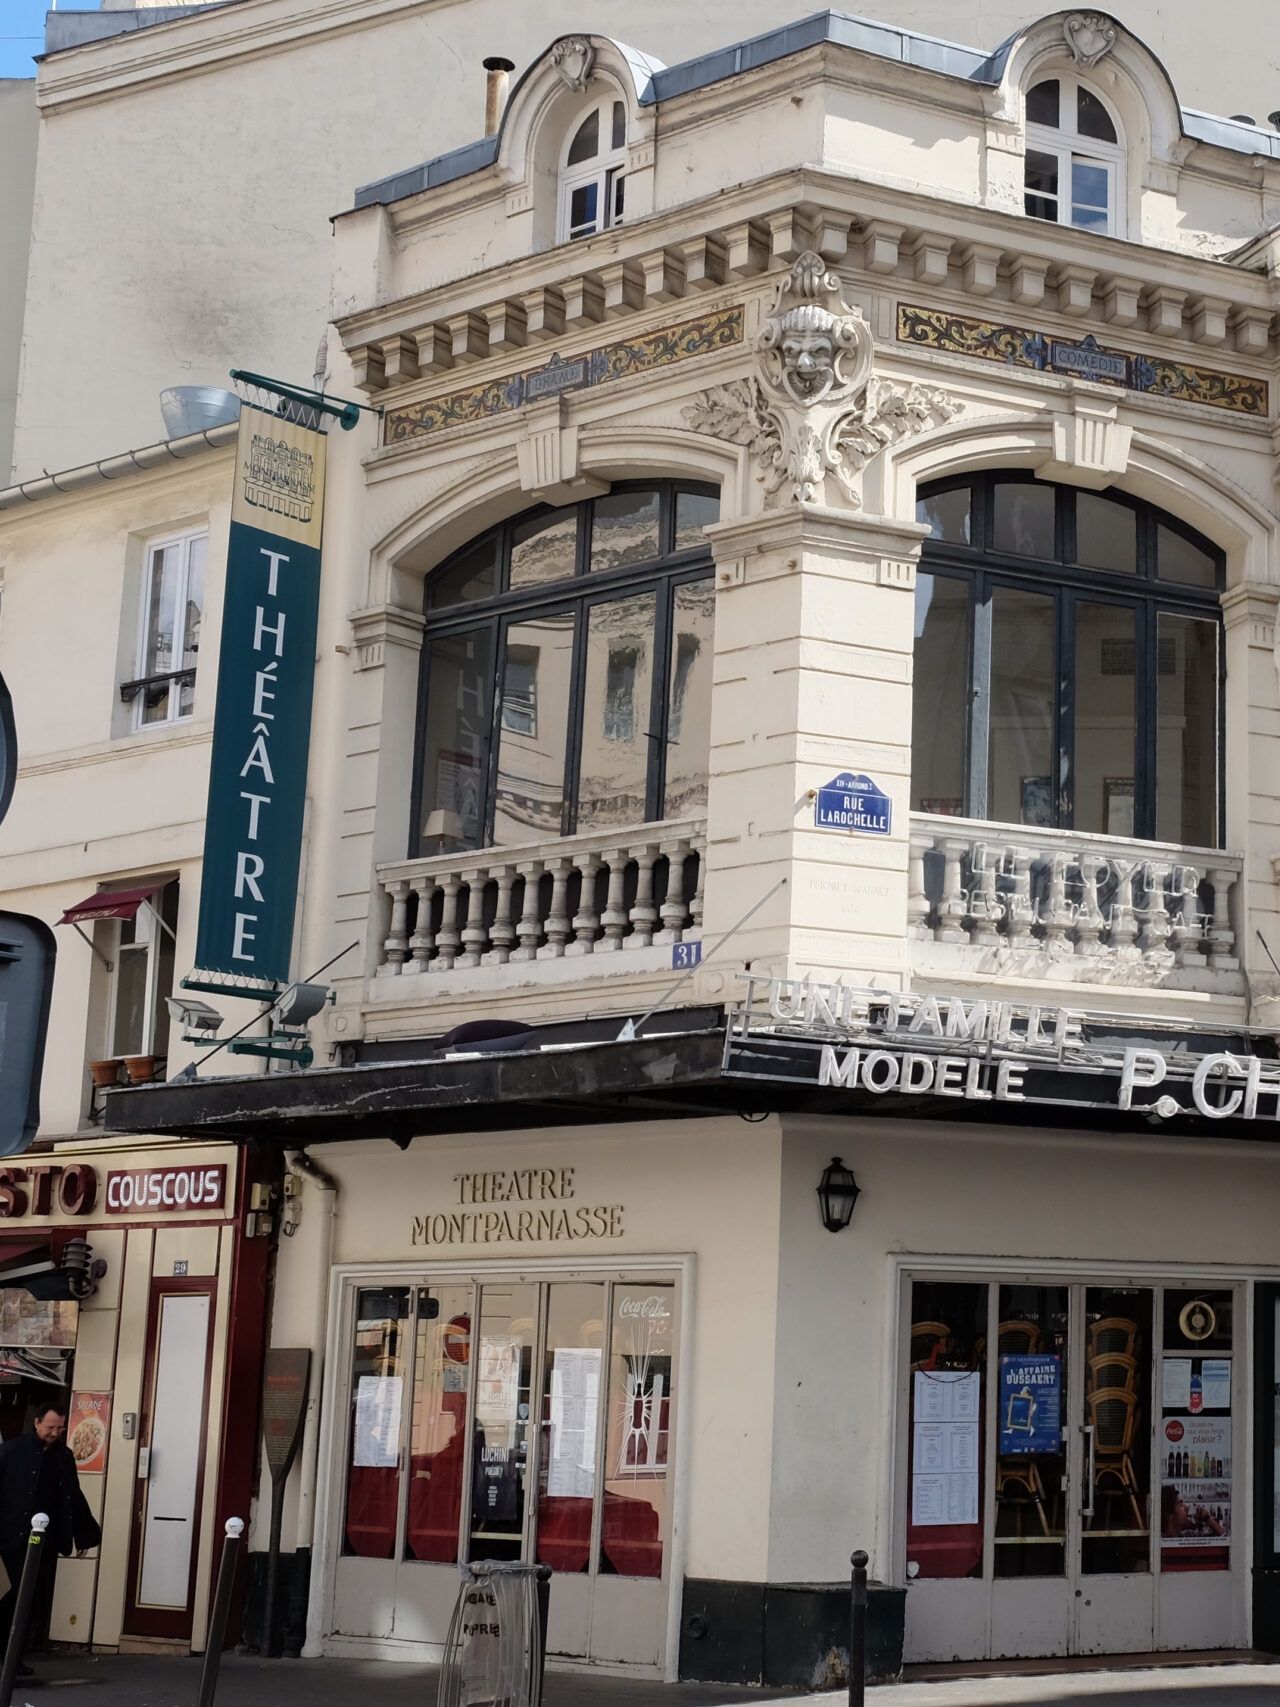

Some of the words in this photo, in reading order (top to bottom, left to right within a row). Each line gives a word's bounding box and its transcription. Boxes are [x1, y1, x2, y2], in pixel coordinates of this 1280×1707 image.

[1059, 351, 1122, 374] COMEDIE
[535, 367, 579, 390] DRAME
[232, 547, 290, 962] THÉÂTRE
[843, 796, 864, 811] RUE
[820, 809, 886, 829] LAROCHELLE
[769, 979, 870, 1027] UNE
[886, 993, 1086, 1047] FAMILLE
[818, 1044, 1029, 1101] MODELE
[107, 1170, 220, 1208] COUSCOUS
[453, 1167, 576, 1206] THEATRE
[410, 1205, 625, 1246] MONTPARNASSE
[1009, 1364, 1056, 1376] L'AFFAIRE
[77, 1399, 103, 1411] SALADE
[1192, 1435, 1216, 1445] plaisir
[481, 1446, 510, 1463] LUCHINI
